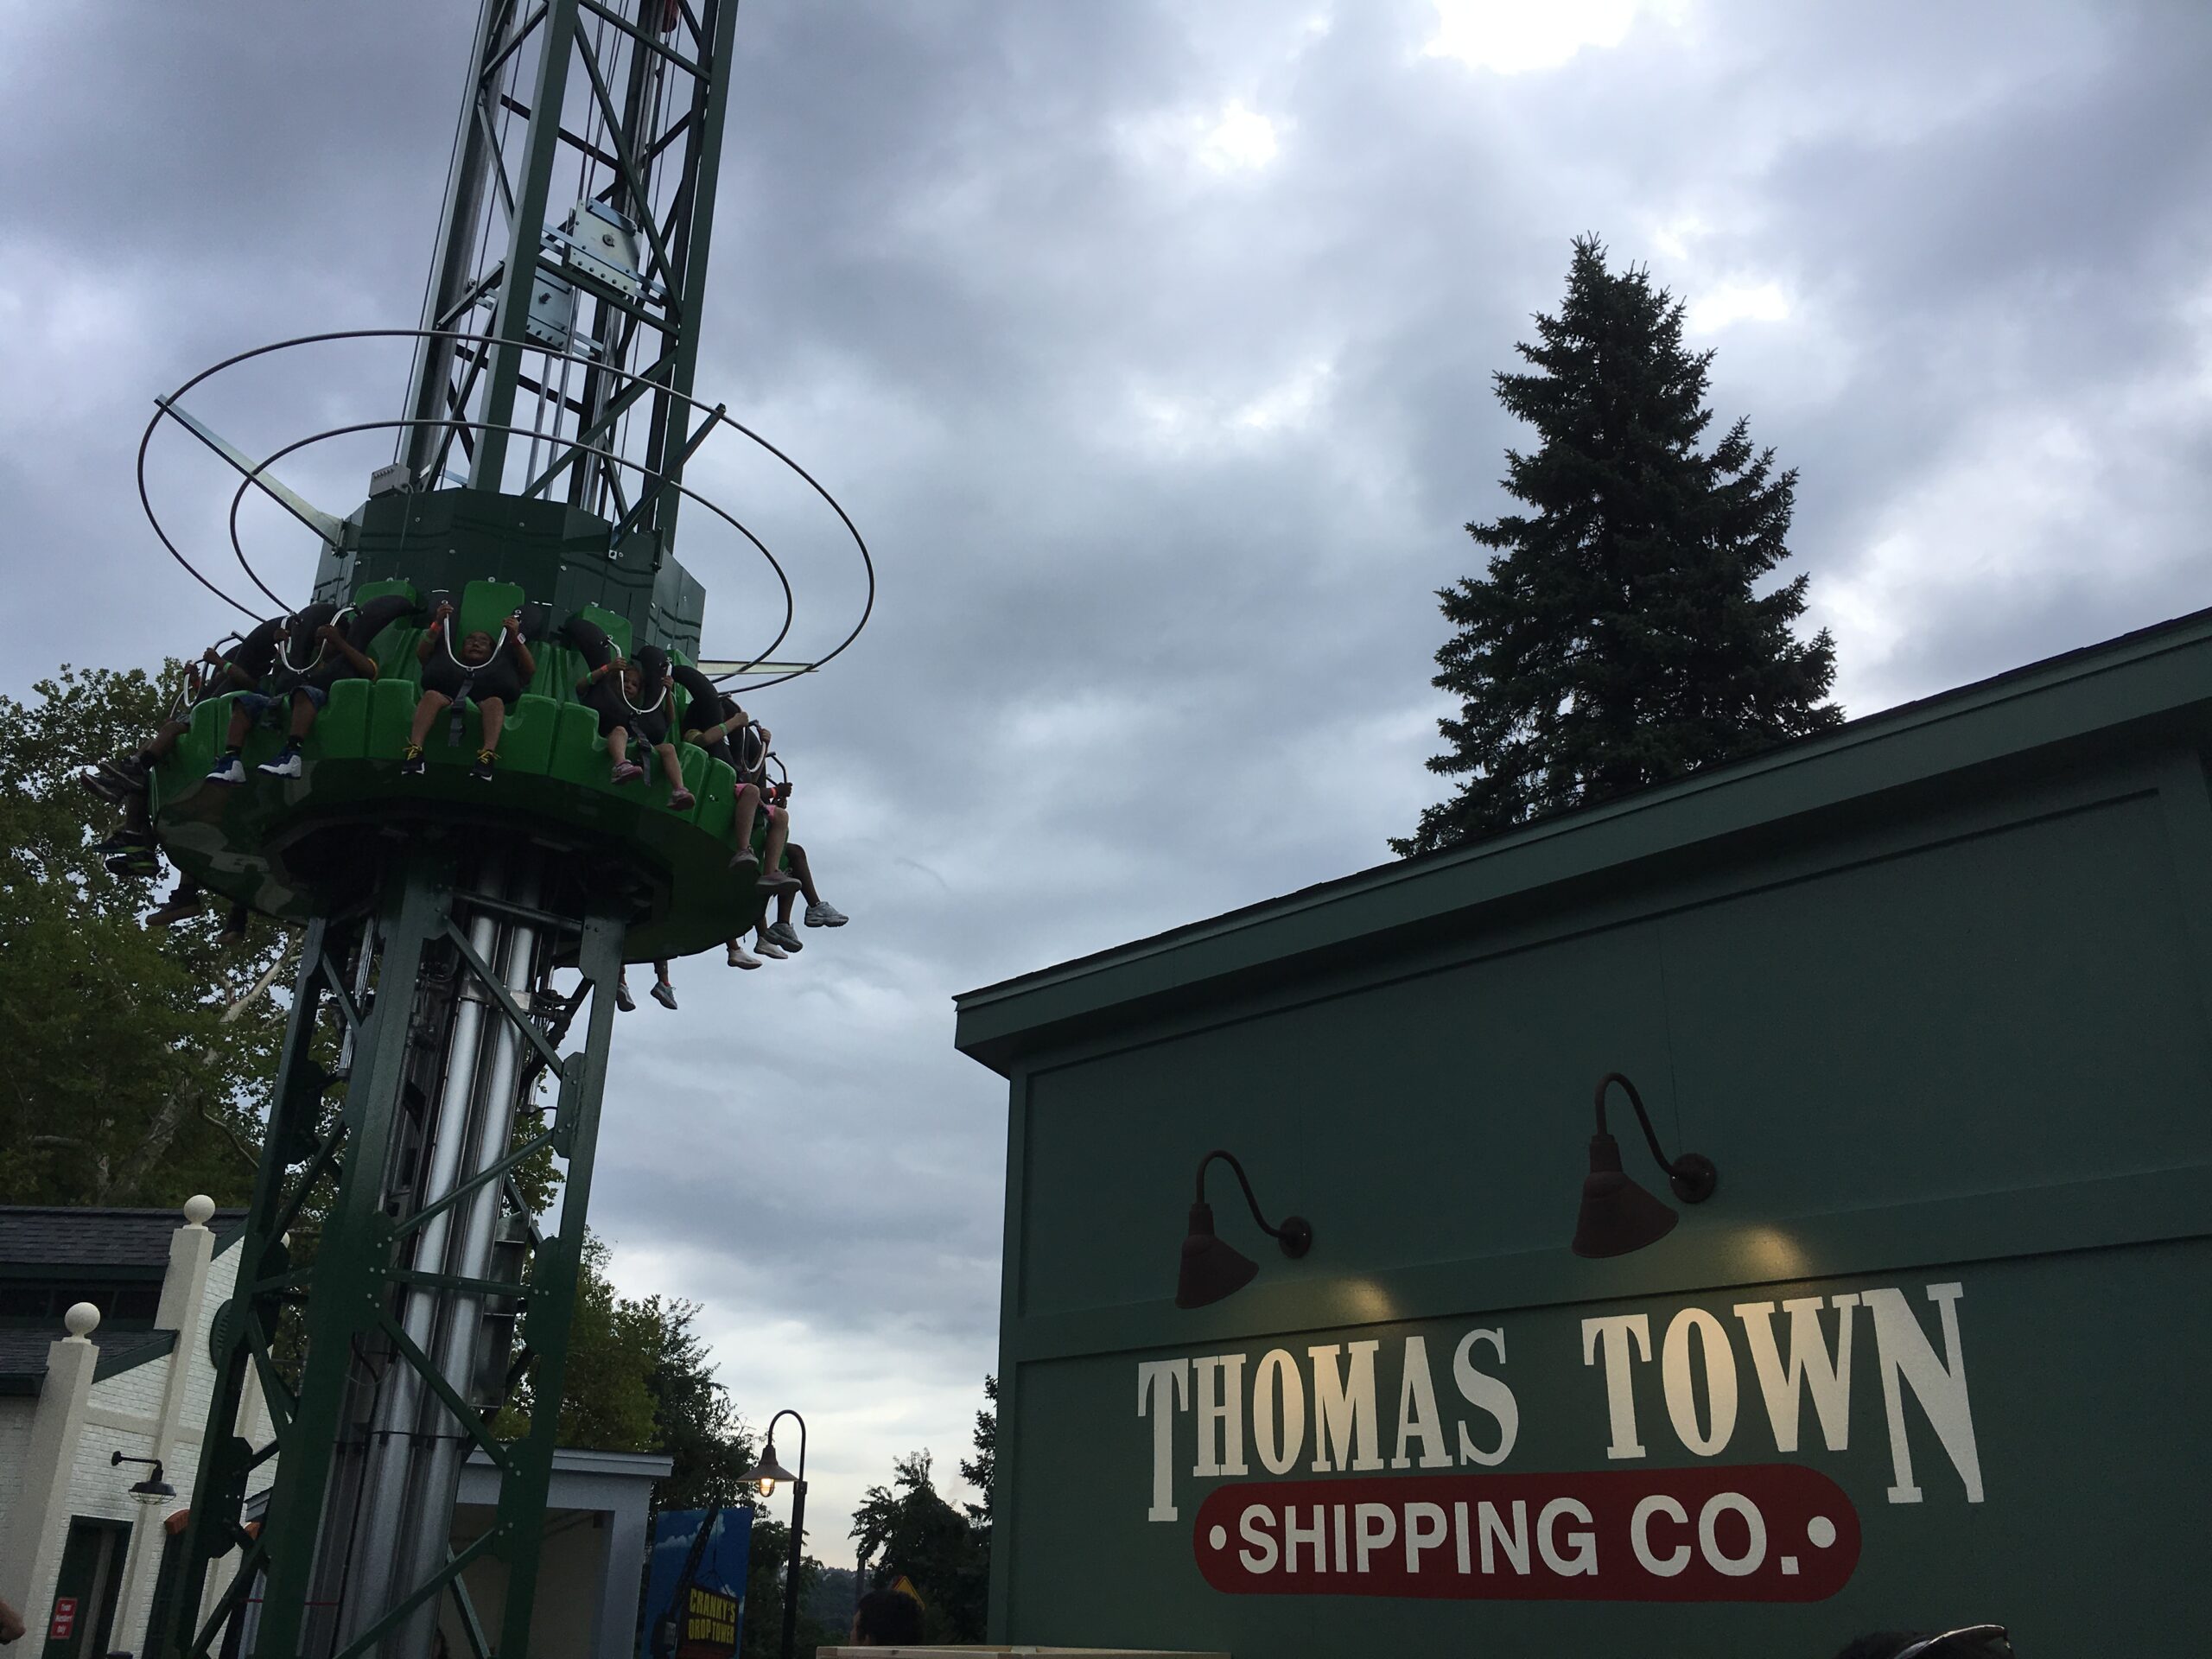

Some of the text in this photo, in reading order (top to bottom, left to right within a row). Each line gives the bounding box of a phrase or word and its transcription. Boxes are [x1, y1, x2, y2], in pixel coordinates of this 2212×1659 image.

[1137, 1281, 1985, 1522] THOMAS TOWN
[1238, 1491, 1800, 1578] SHIPPING CO.
[688, 1618, 734, 1644] DROP TOWER
[690, 1588, 736, 1624] CRANKY'S
